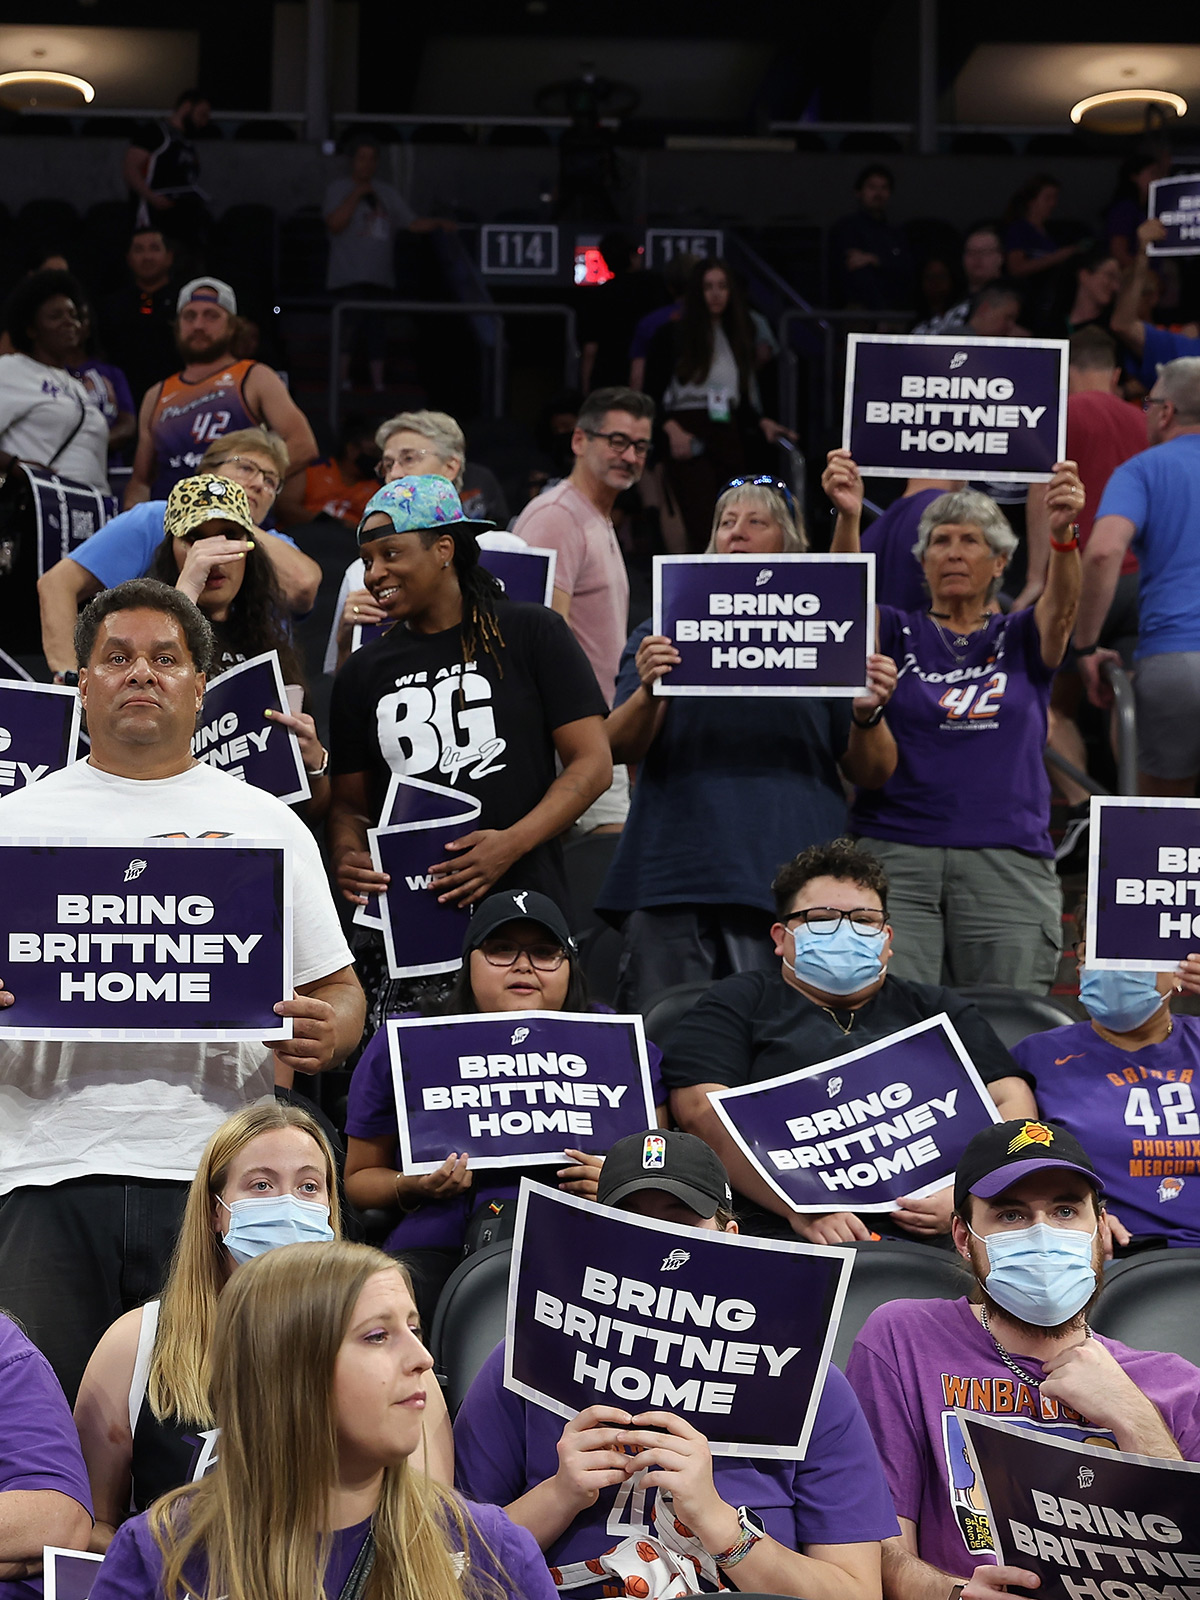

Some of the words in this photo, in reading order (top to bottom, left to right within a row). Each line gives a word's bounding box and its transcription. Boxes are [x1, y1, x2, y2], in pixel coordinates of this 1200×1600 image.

[496, 232, 543, 267] 114
[900, 375, 1015, 401] BRING
[190, 410, 232, 443] 42
[865, 401, 1047, 429] BRITTNEY
[900, 429, 1010, 455] HOME
[709, 593, 821, 616] BRING
[675, 619, 854, 643] BRITTNEY
[394, 671, 428, 688] WE
[434, 660, 478, 680] ARE
[711, 646, 818, 670] HOME
[938, 672, 1008, 719] 42
[376, 672, 497, 777] BG
[439, 737, 507, 786] 42
[56, 894, 215, 926] BRING
[7, 932, 264, 965] BRITTNEY
[59, 971, 212, 1003] HOME
[459, 1052, 588, 1079] BRING
[422, 1081, 628, 1112] BRITTNEY
[786, 1081, 913, 1143] BRING
[1124, 1081, 1200, 1137] 42
[468, 1109, 594, 1138] HOME
[765, 1088, 961, 1173] BRITTNEY
[822, 1135, 942, 1192] HOME
[1132, 1139, 1200, 1158] PHOENIX
[581, 1265, 757, 1332] BRING
[533, 1289, 802, 1377] BRITTNEY
[572, 1349, 737, 1415] HOME
[940, 1372, 1038, 1418] WNBA
[1031, 1488, 1183, 1545] BRING
[1008, 1517, 1200, 1580] BRITTNE
